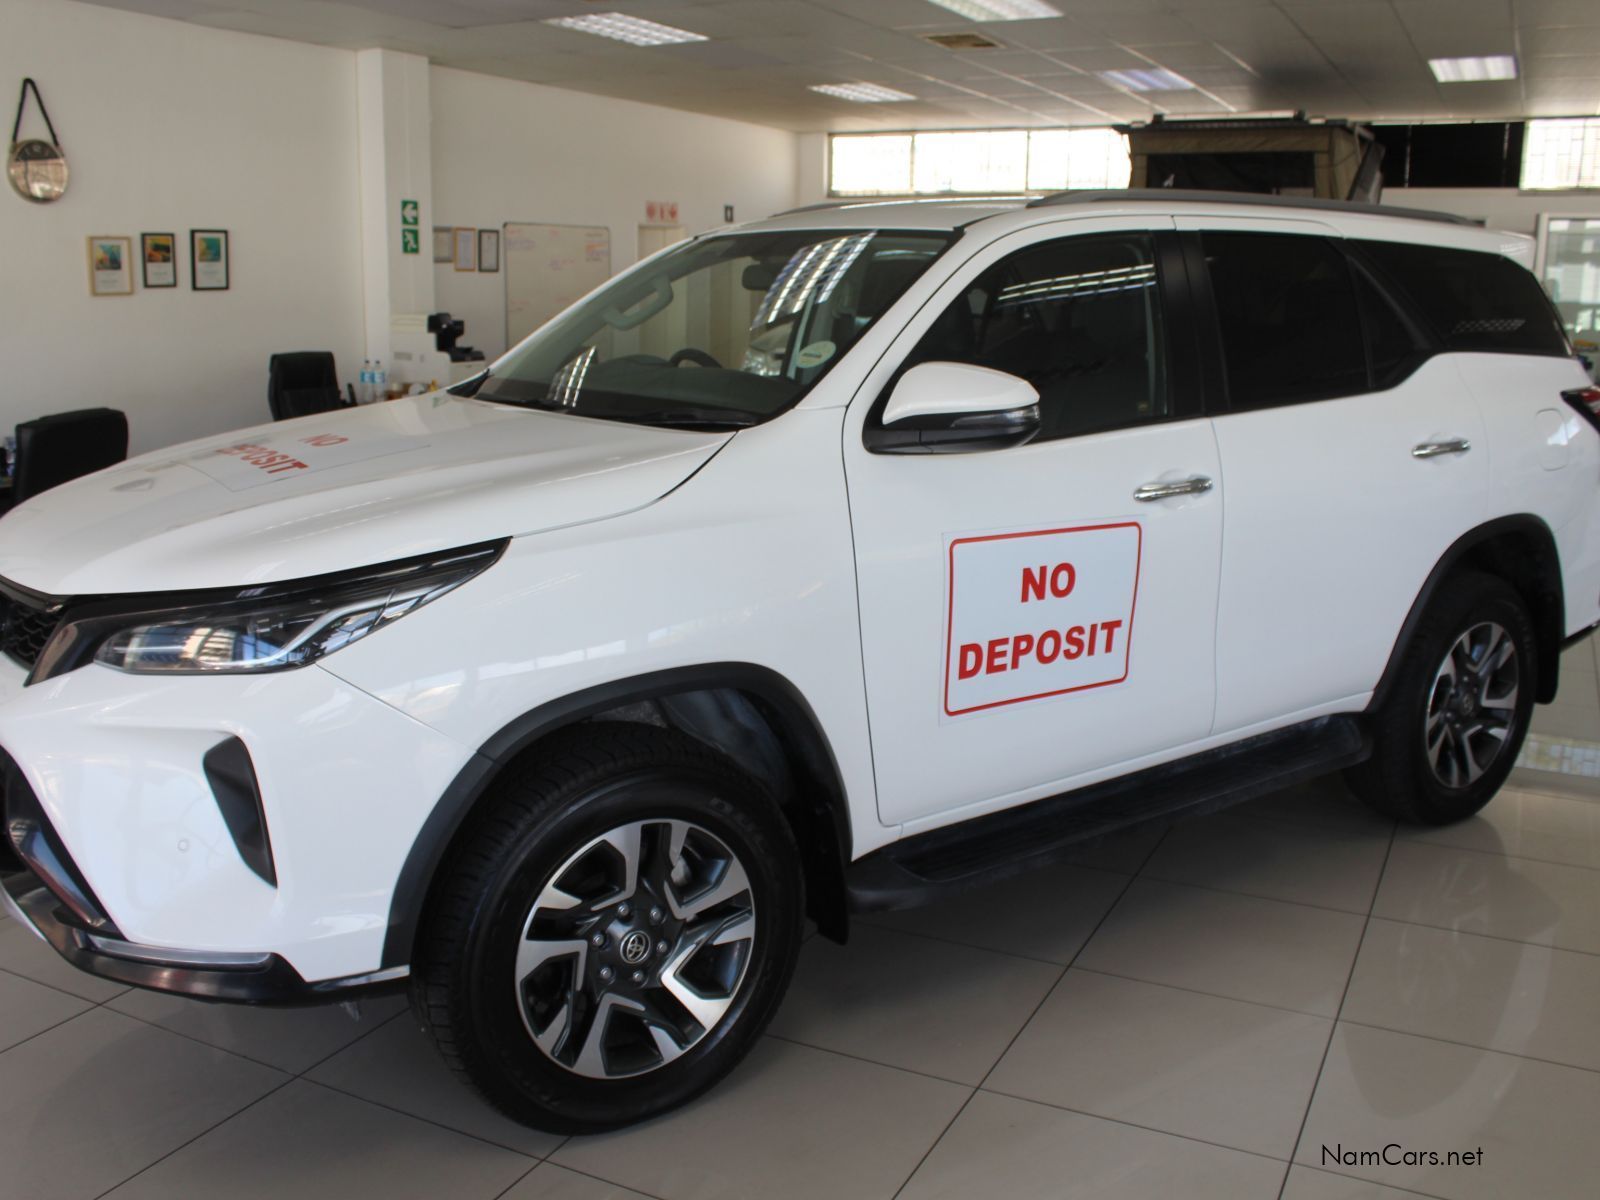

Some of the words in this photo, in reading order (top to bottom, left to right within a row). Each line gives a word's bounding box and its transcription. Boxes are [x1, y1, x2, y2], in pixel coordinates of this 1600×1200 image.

[297, 433, 350, 447] NO
[1020, 562, 1077, 603] NO
[958, 619, 1123, 681] DEPOSIT
